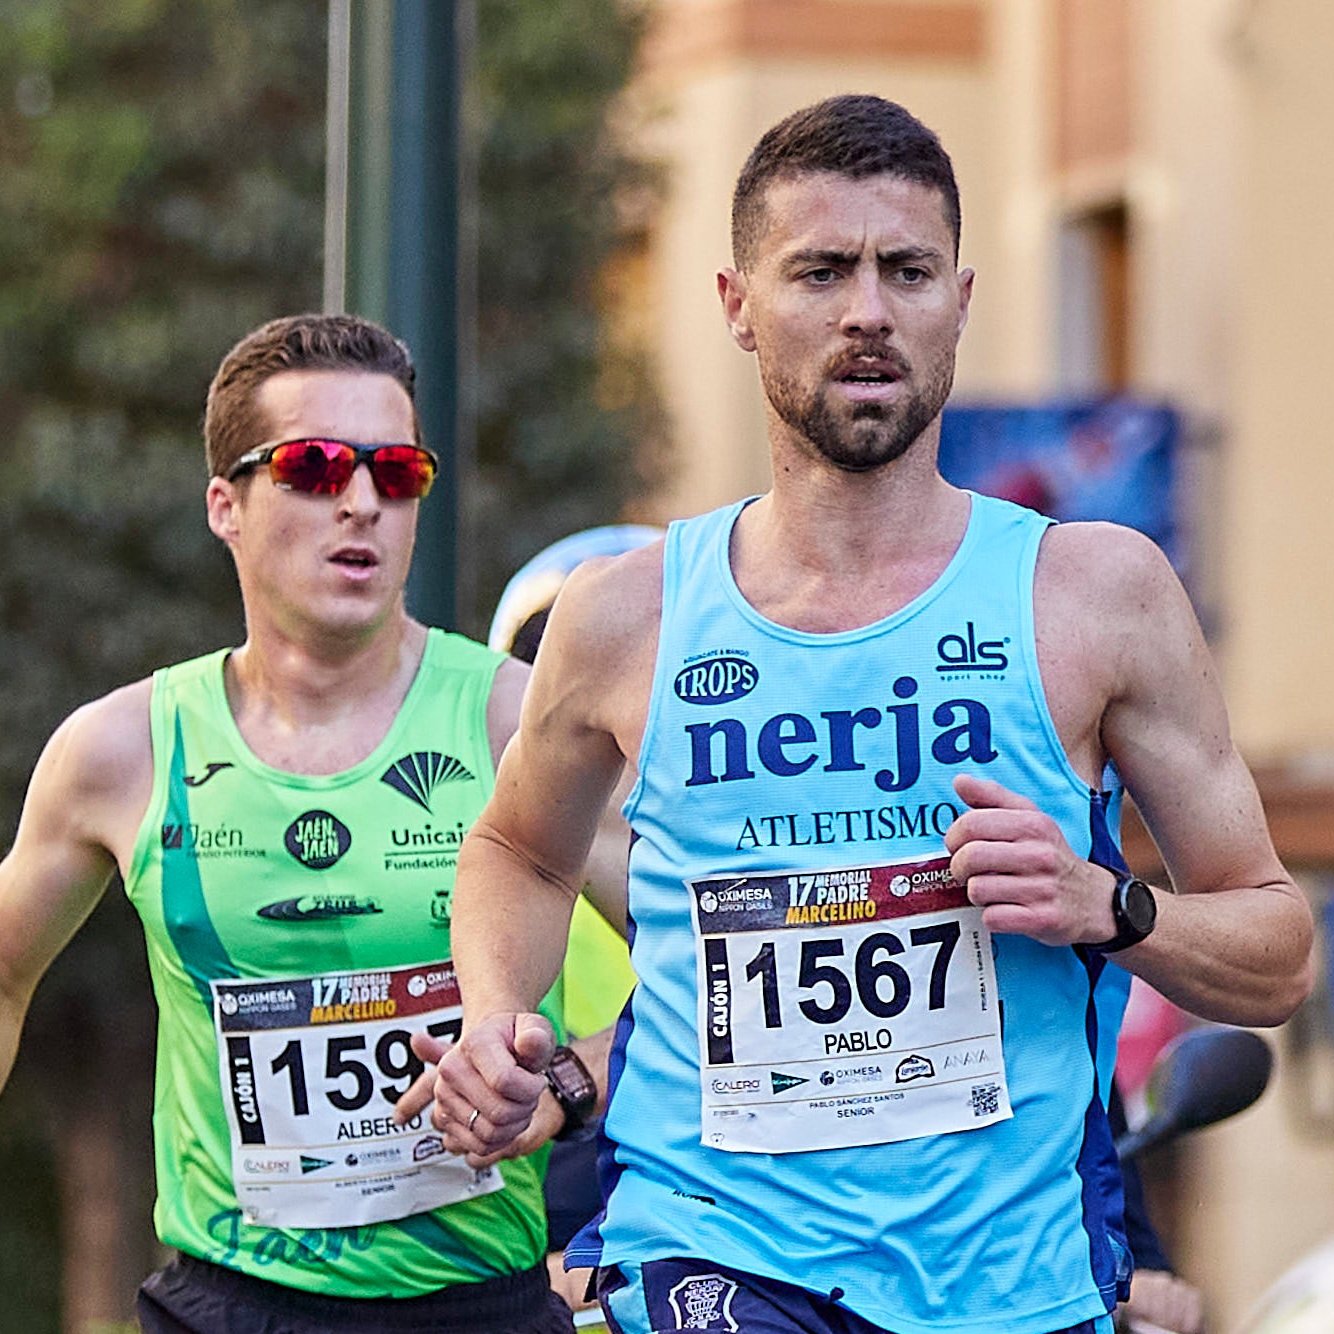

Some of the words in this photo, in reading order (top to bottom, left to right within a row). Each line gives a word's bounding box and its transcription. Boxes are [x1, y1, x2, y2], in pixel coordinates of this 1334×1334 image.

[936, 622, 1008, 671] als
[678, 661, 755, 697] TROPS
[684, 676, 999, 793] nerja
[186, 822, 243, 848] Jaén
[391, 822, 466, 846] Unicaj
[736, 802, 959, 850] ATLETISMO
[385, 858, 457, 870] Fundación
[815, 870, 872, 887] MEMORIAL
[717, 888, 773, 902] OXIMESA
[788, 876, 815, 906] 17
[817, 883, 868, 905] PADRE
[785, 900, 876, 924] MARCELINO
[339, 972, 391, 988] MEMORIAL
[745, 921, 961, 1029] 1567
[238, 990, 296, 1005] OXIMESA
[312, 979, 339, 1007] 17
[341, 985, 389, 1004] PADRE
[310, 1000, 396, 1023] MARCELINO
[711, 987, 728, 1038] CAJÓN
[824, 1028, 892, 1054] PABLO
[944, 1050, 989, 1069] ANAYA
[836, 1066, 882, 1078] OXIMESA
[810, 1100, 835, 1109] PABLO
[874, 1093, 905, 1102] SANTOS
[837, 1107, 875, 1118] SENIOR
